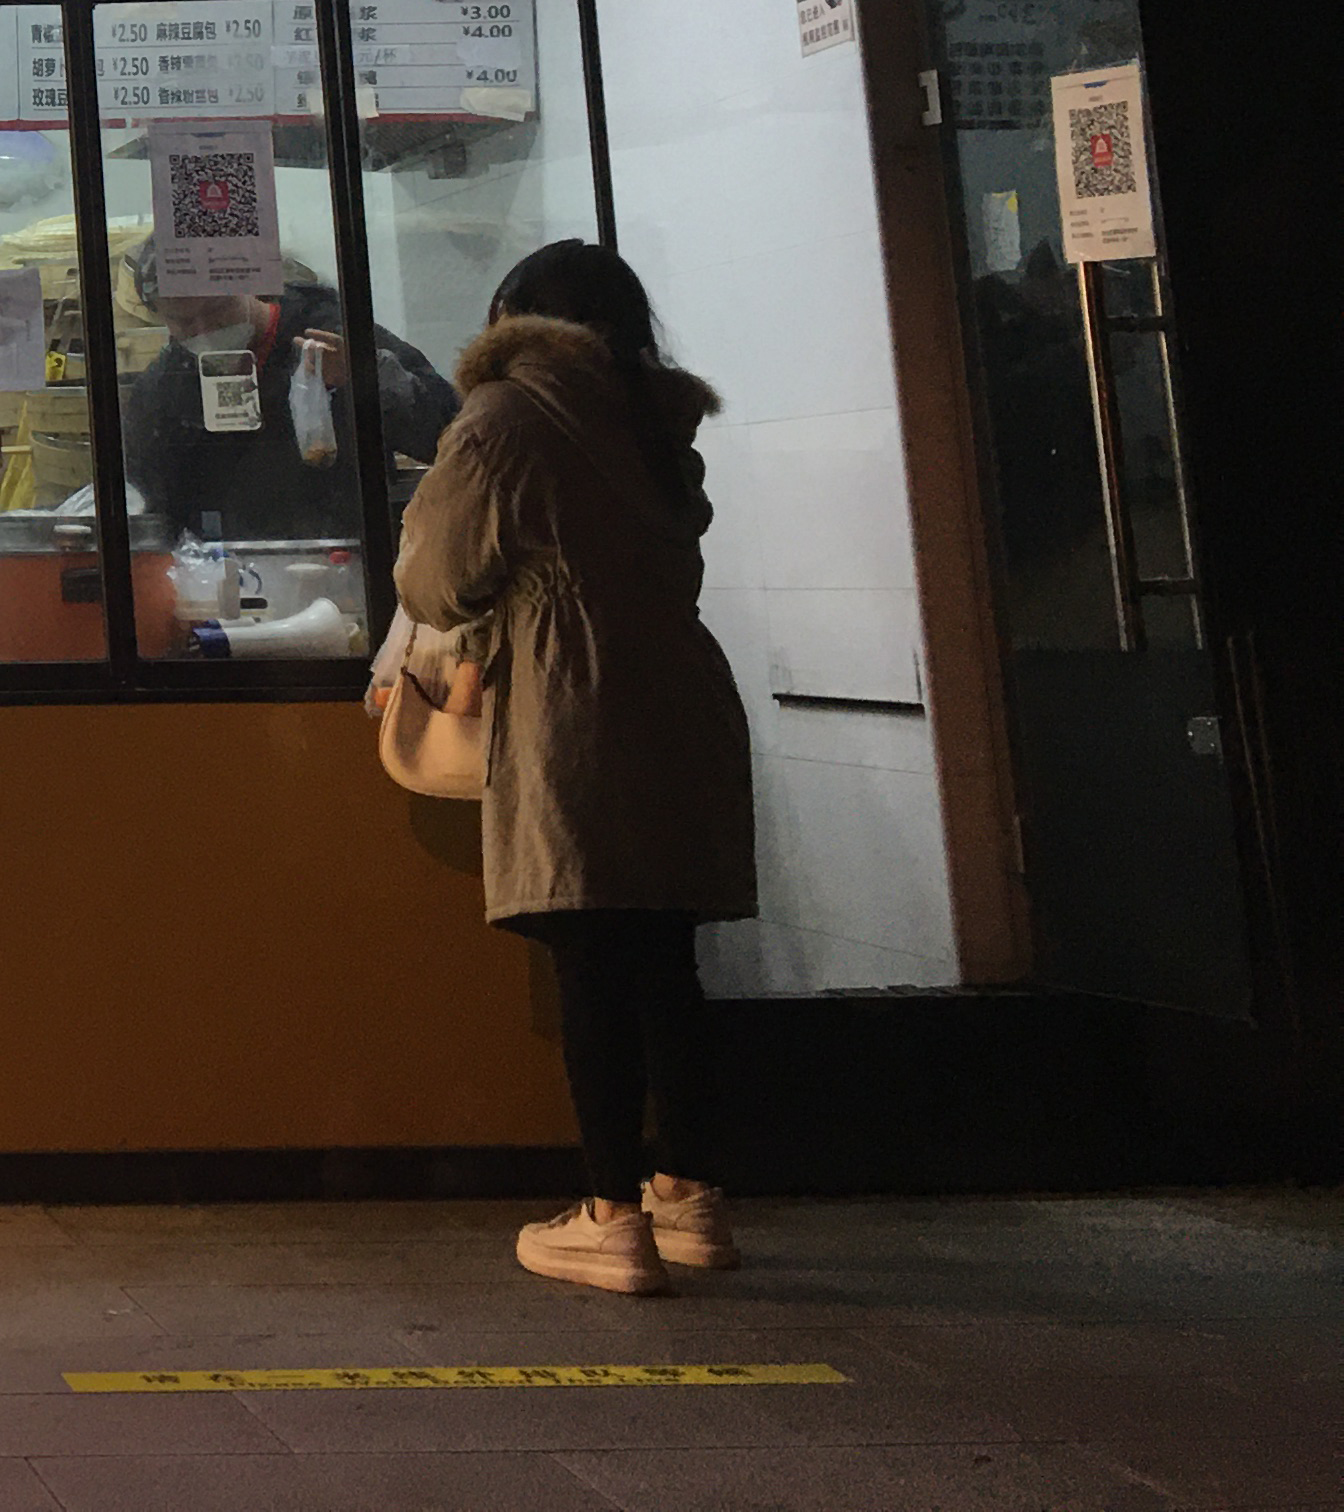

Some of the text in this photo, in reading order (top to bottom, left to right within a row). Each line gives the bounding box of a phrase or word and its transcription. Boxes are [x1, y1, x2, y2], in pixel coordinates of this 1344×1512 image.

[155, 21, 217, 42] 麻辣豆腐包
